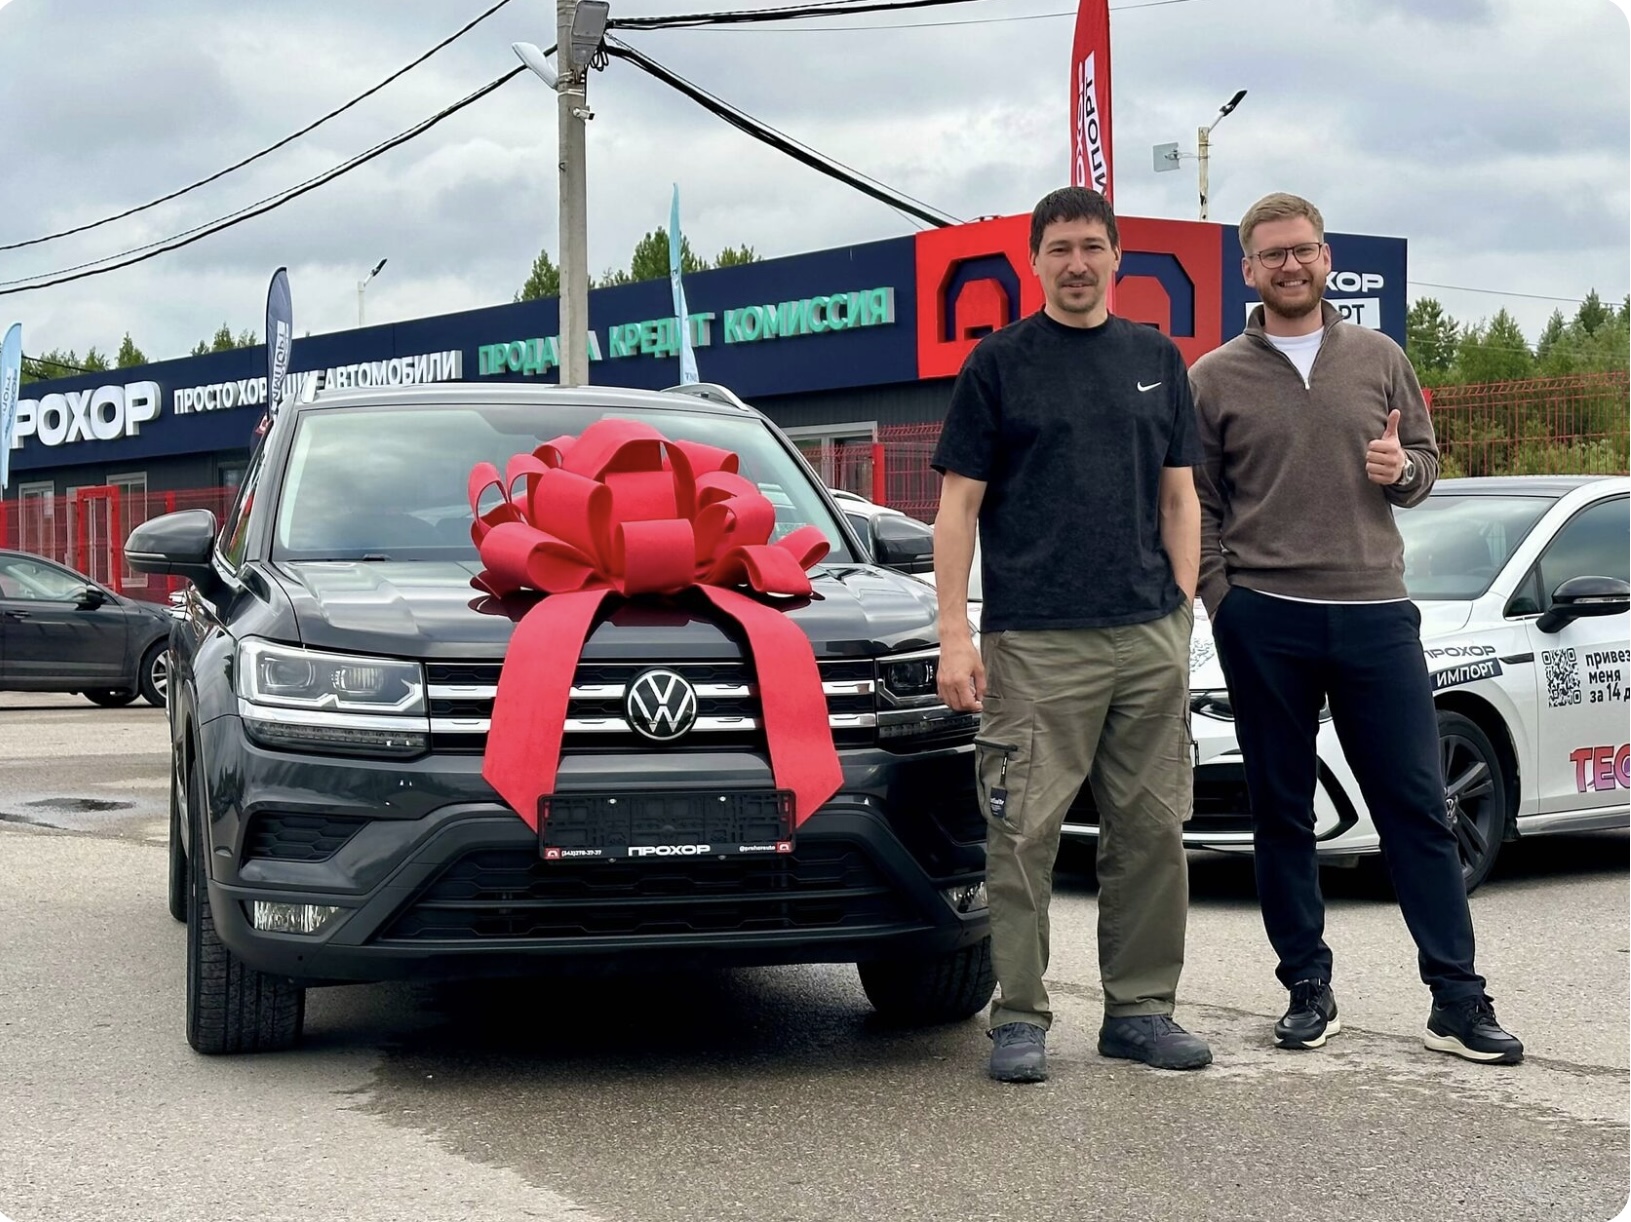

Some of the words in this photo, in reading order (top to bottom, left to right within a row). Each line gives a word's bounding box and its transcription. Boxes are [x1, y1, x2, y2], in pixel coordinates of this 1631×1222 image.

[1076, 61, 1085, 187] ОХОР
[1085, 76, 1107, 196] МПОРТ
[1326, 271, 1384, 292] ХОР
[478, 330, 602, 376] ПРОДА
[724, 286, 895, 344] КОМИССИЯ
[174, 381, 239, 415] ПРОСТО
[325, 350, 462, 391] АВТОМОБИЛИ
[12, 381, 162, 449] РОХОР
[1436, 661, 1495, 687] ИМПОРТ
[1588, 669, 1621, 685] меня
[1590, 690, 1604, 703] за
[1606, 682, 1621, 701] 14
[628, 844, 711, 857] ПРОХОР
